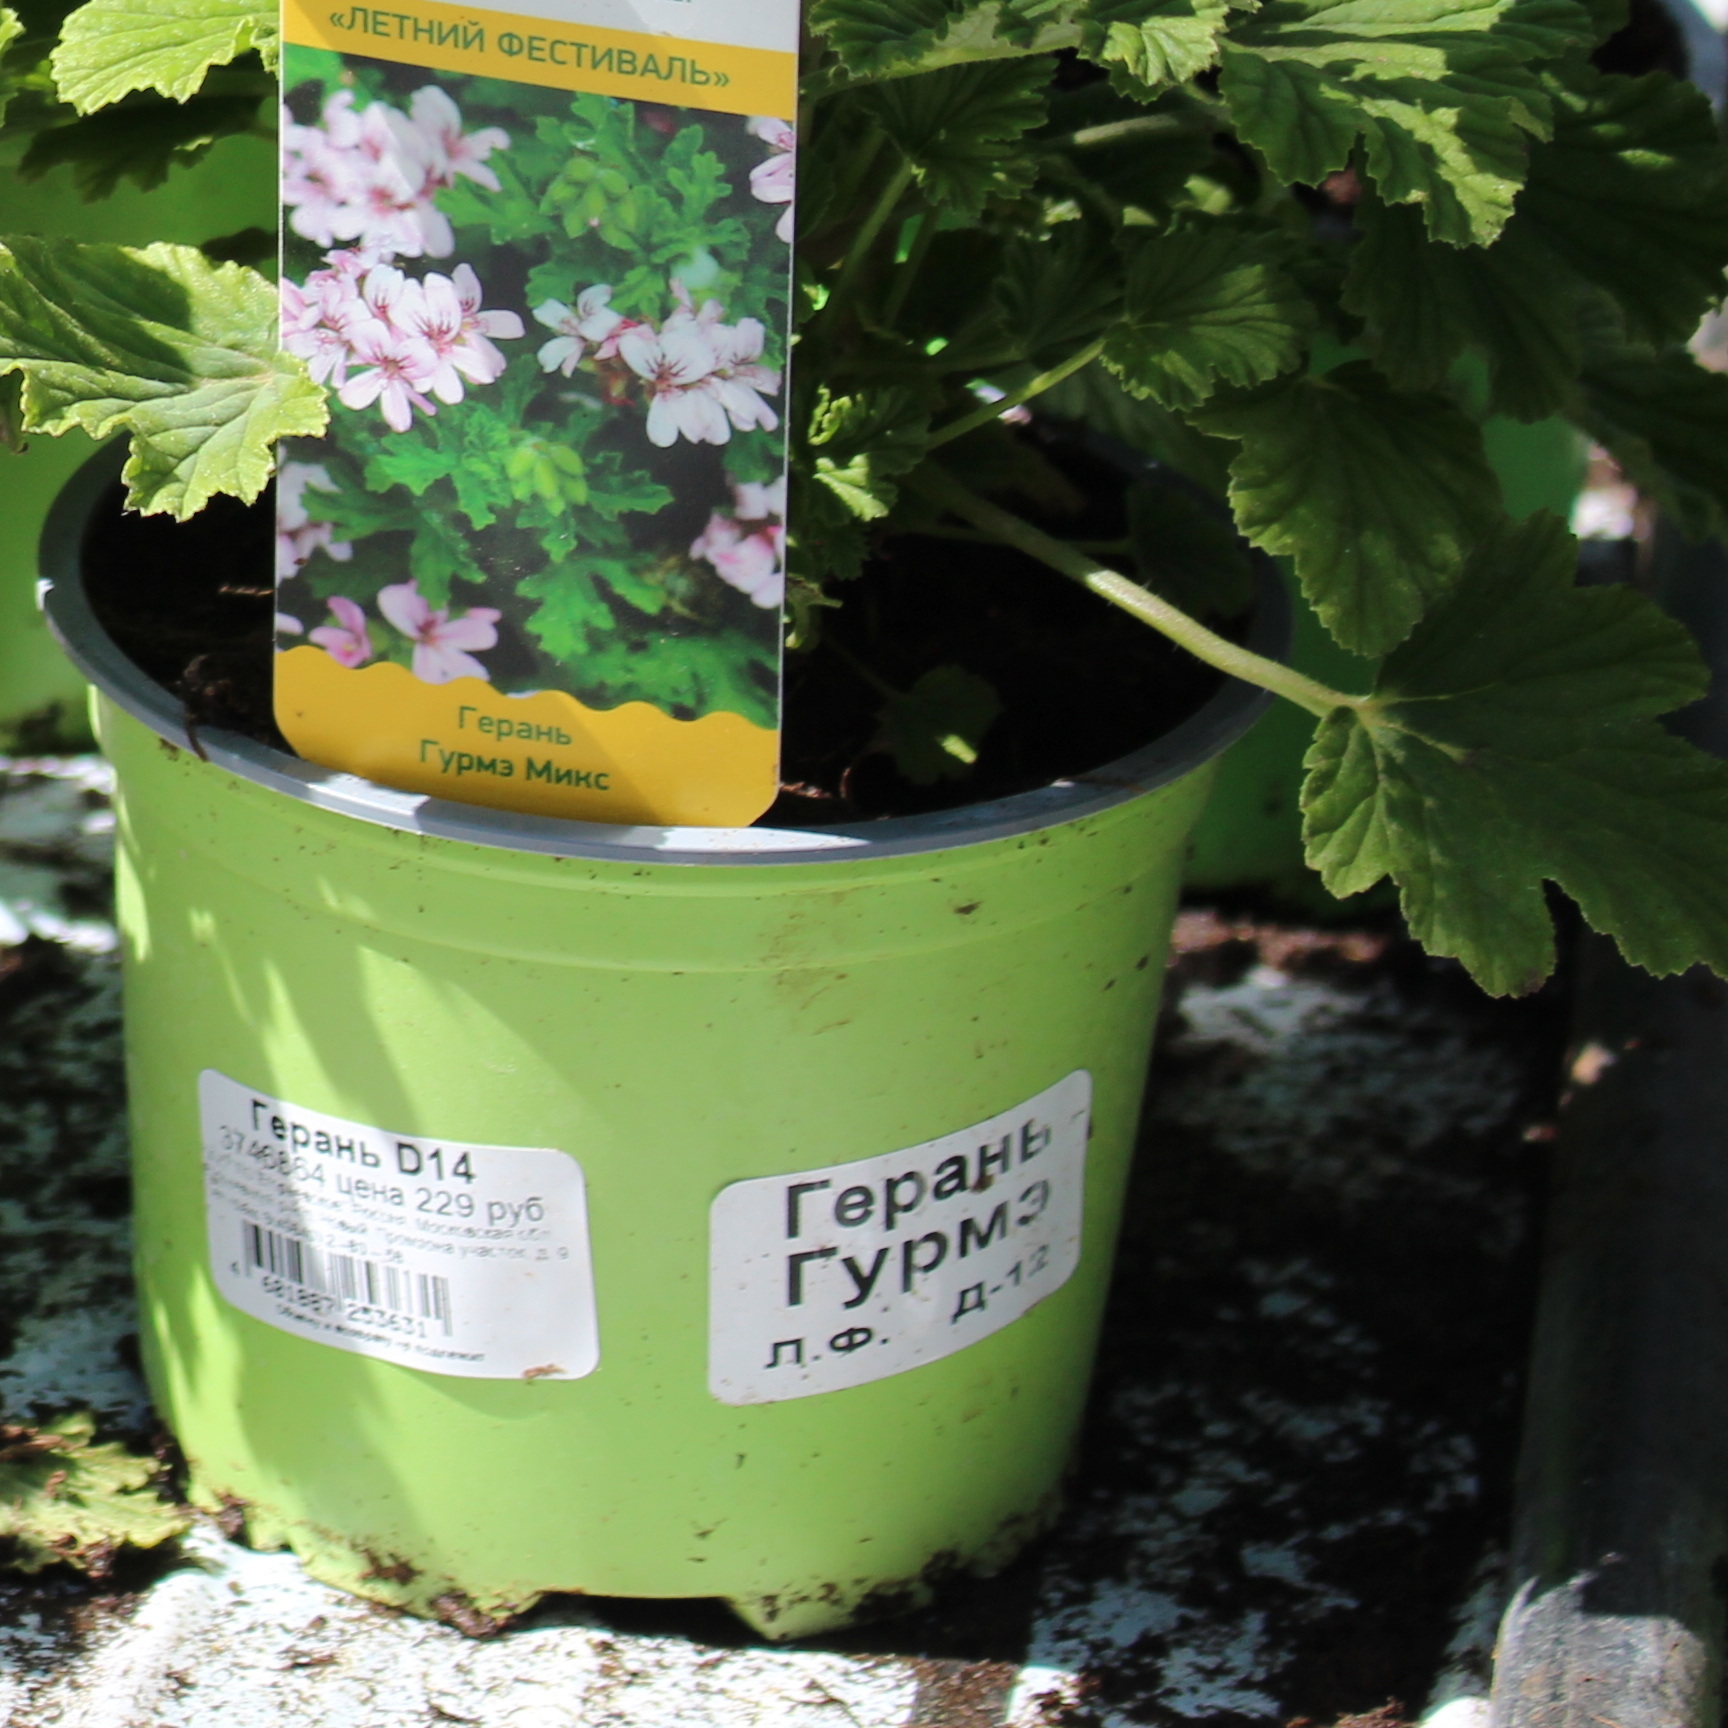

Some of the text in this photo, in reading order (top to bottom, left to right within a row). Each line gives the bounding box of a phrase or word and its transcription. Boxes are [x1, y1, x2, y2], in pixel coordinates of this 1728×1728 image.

[329, 6, 730, 89] «ЛЕТНИЙ ФЕСТИВАЛЬ»
[420, 739, 610, 792] Гурмэ Микс
[458, 706, 572, 746] Герань
[252, 1098, 476, 1185] Герань D14
[786, 1117, 1052, 1239] Герань
[336, 1171, 405, 1208] цена
[416, 1187, 475, 1217] 229
[487, 1195, 543, 1229] руб
[787, 1179, 1051, 1309] Гурмэ
